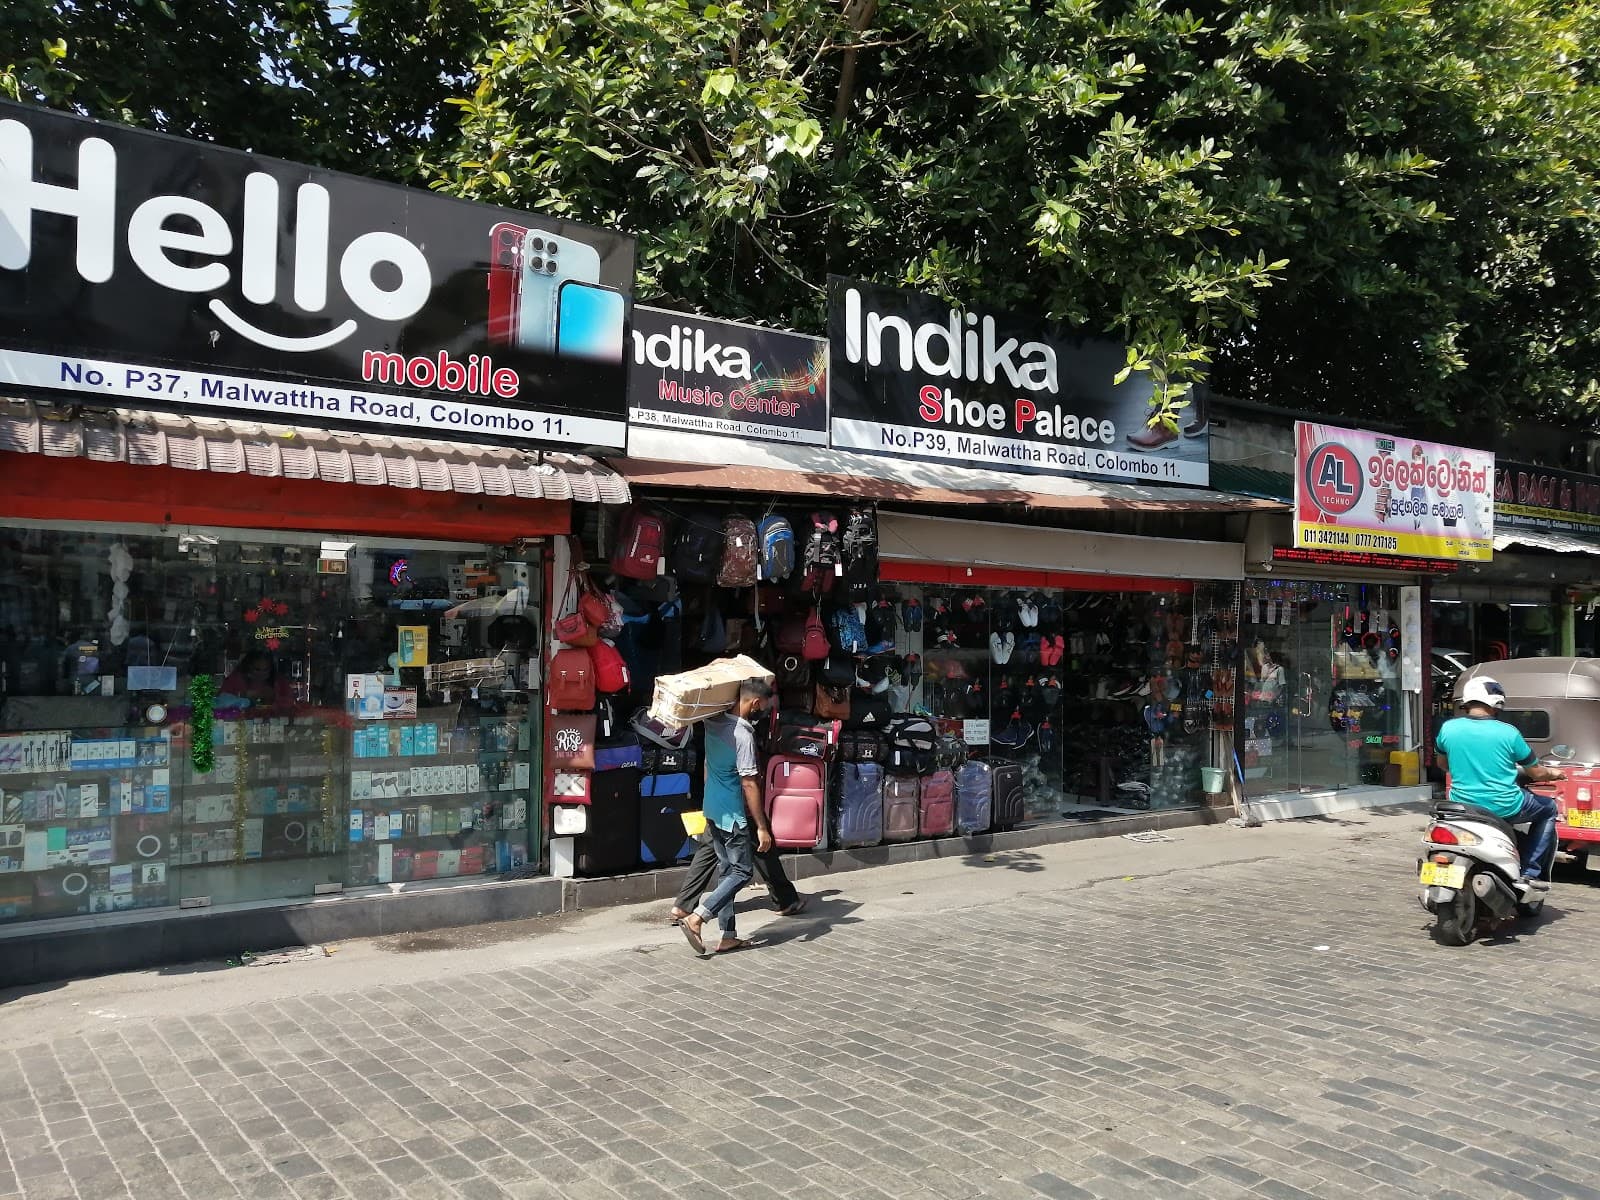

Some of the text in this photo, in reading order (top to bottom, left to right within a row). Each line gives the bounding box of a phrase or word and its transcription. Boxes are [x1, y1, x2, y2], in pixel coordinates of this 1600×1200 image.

[0, 119, 432, 320] Hello
[845, 289, 1059, 393] Indika
[361, 349, 520, 398] mobile
[59, 361, 571, 436] No. P37, Malwattha Road, Colombo 11.
[658, 378, 801, 417] Music Center
[919, 385, 1116, 445] Shoe Palace
[662, 414, 713, 430] Malwattha
[746, 425, 788, 439] Colombo
[956, 437, 1043, 464] Malwattha
[1047, 447, 1092, 470] Road,
[1095, 451, 1159, 475] Colombo
[1162, 460, 1181, 478] 11.
[1318, 453, 1353, 496] AL
[1322, 496, 1350, 506] TECHNO
[1304, 529, 1398, 550] 011 3421144 0777 217185
